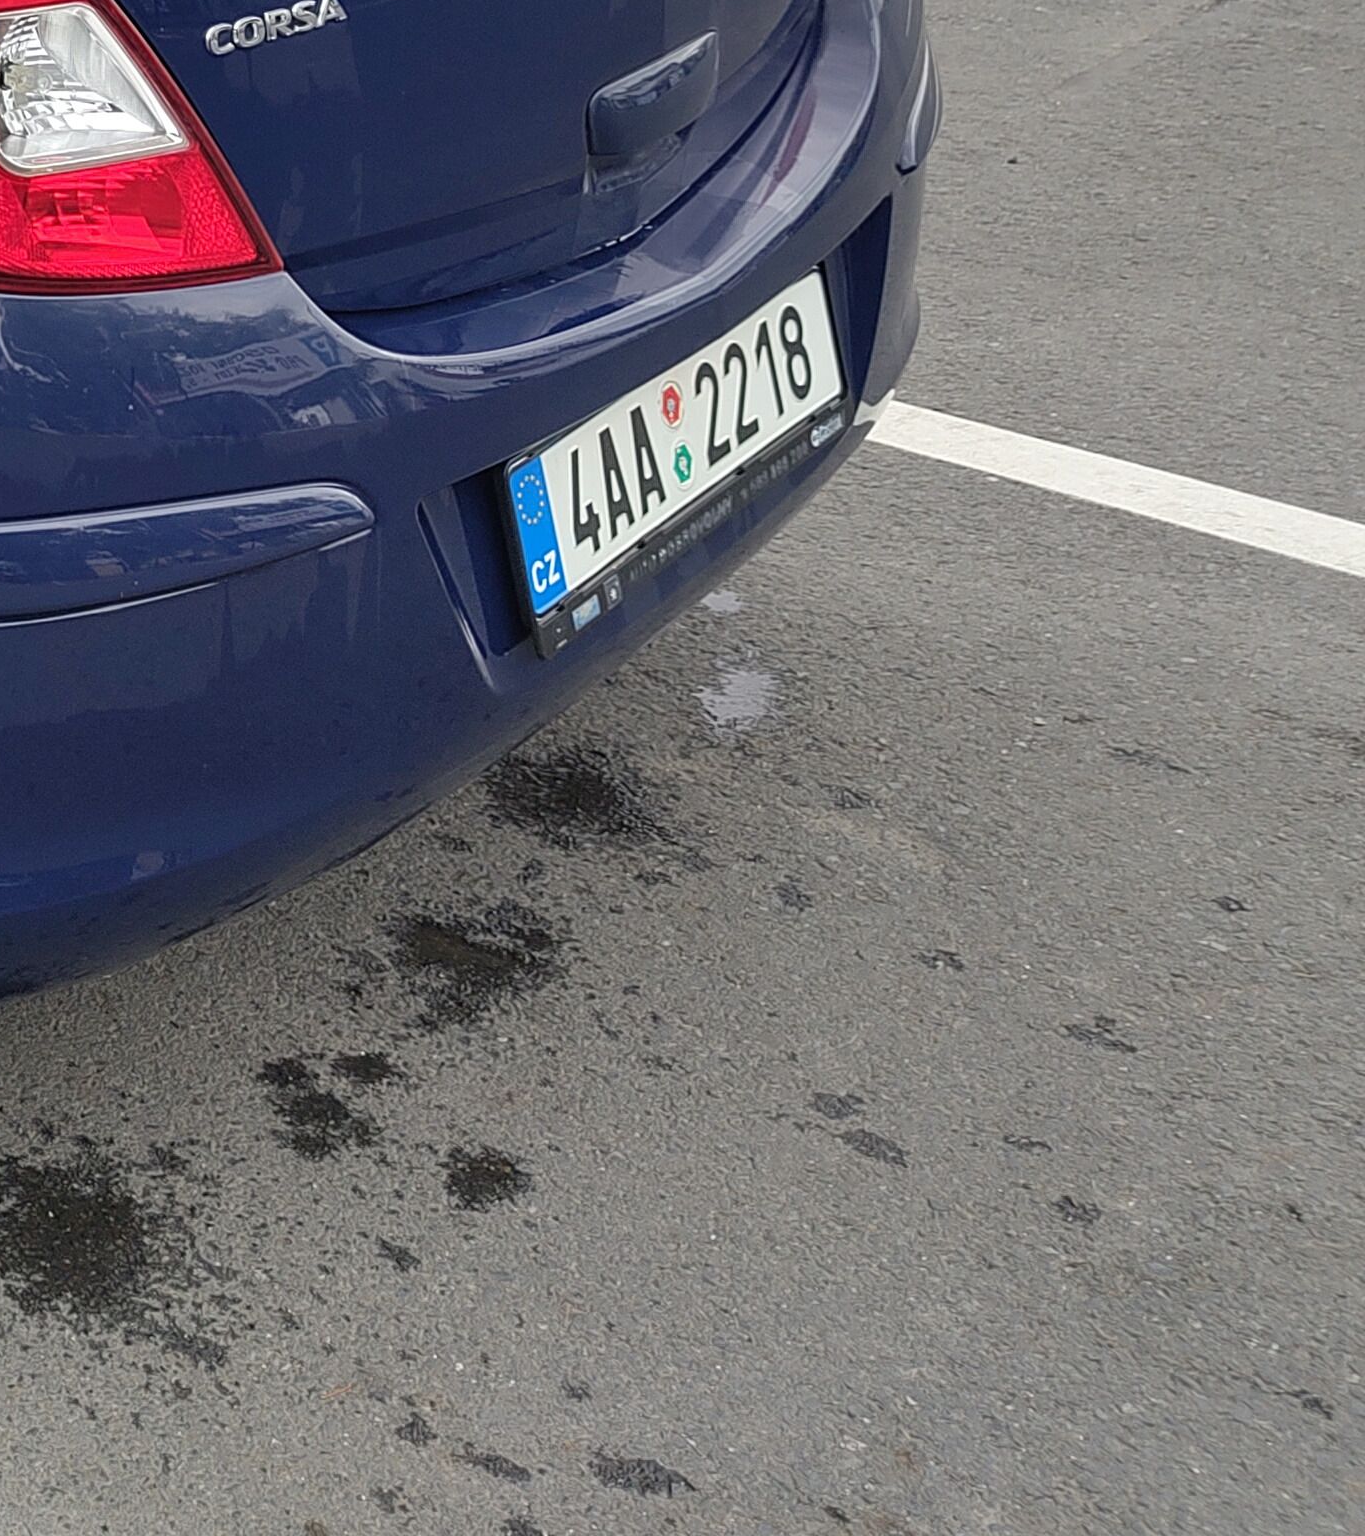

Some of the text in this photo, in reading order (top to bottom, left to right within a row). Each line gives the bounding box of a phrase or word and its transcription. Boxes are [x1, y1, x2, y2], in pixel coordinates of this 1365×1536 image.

[570, 305, 812, 553] 4AA 2218
[531, 549, 561, 594] CZ
